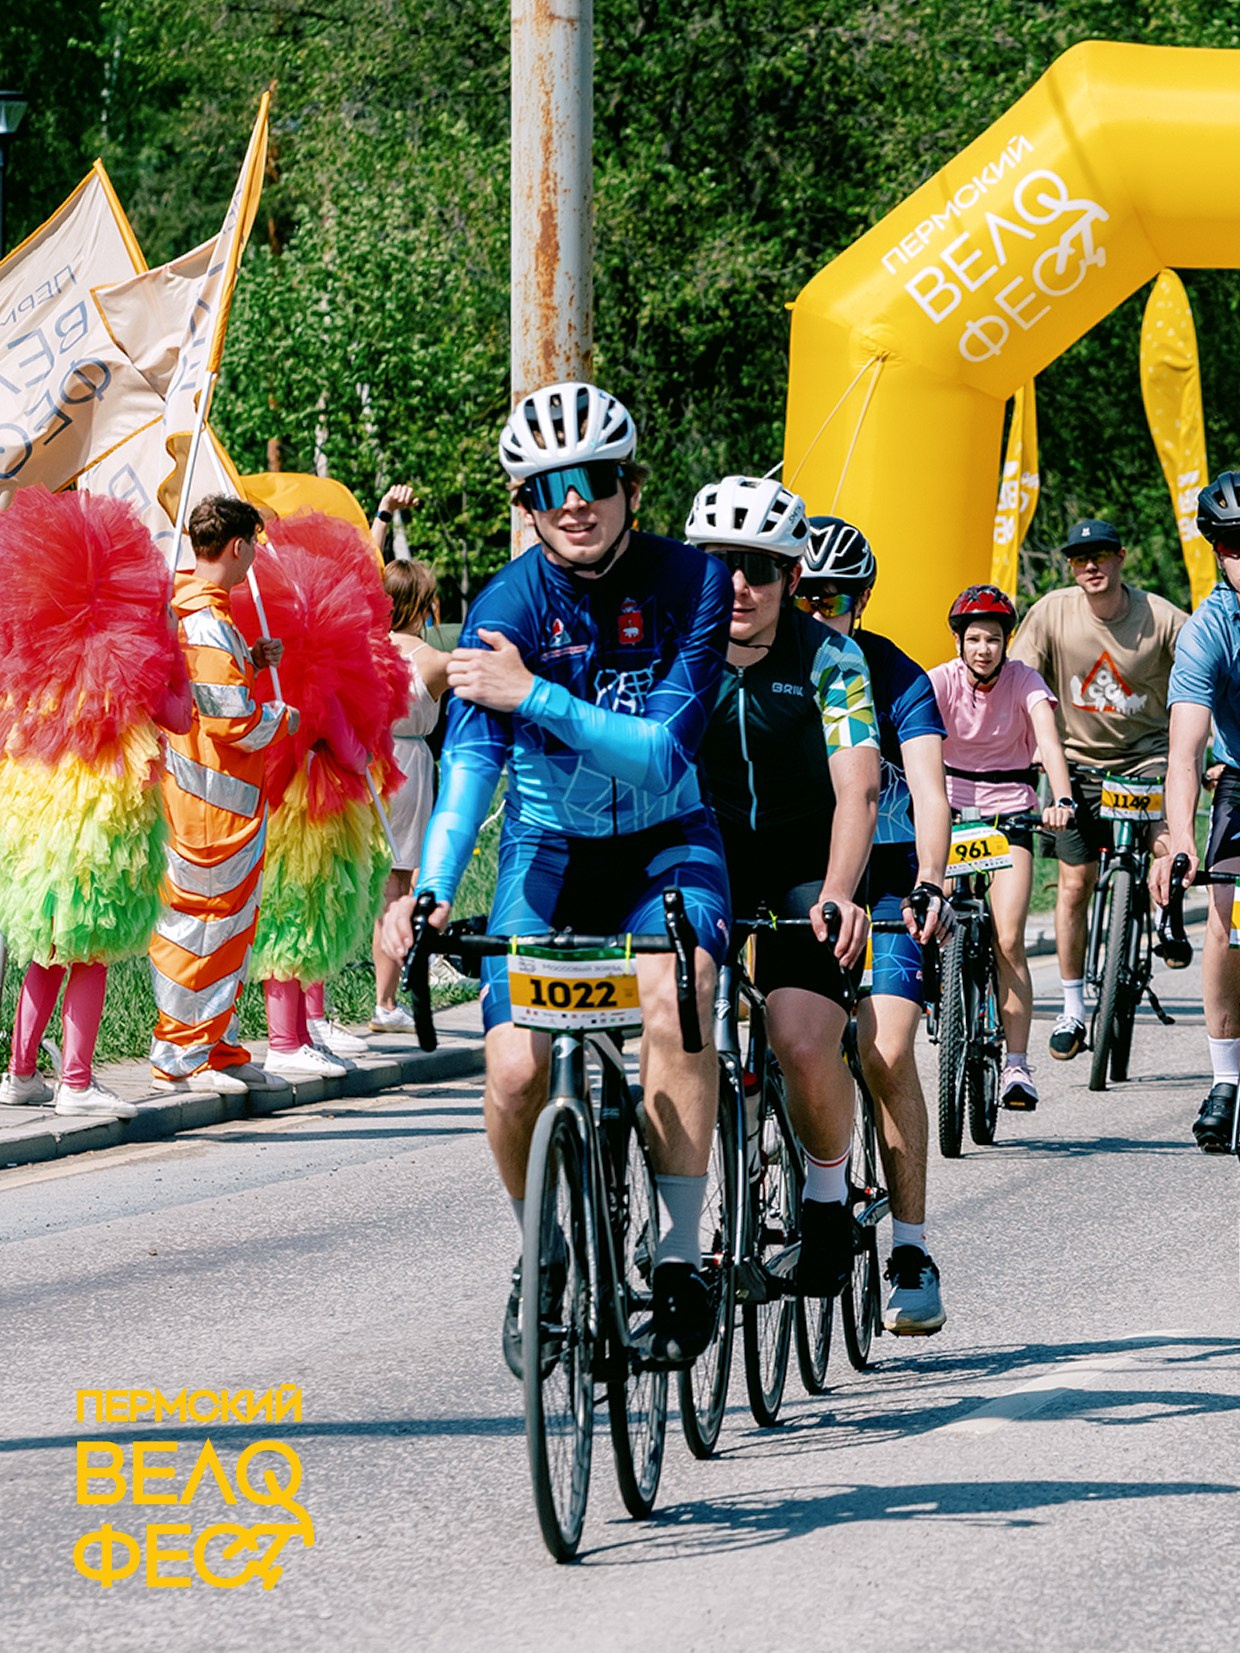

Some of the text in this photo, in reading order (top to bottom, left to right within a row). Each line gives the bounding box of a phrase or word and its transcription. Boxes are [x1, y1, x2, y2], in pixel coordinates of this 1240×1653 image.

[880, 135, 1035, 275] ПЕРМСКИЙ
[904, 169, 1070, 325] ВЕЛО
[955, 840, 992, 861] 961
[530, 978, 618, 1009] 1022
